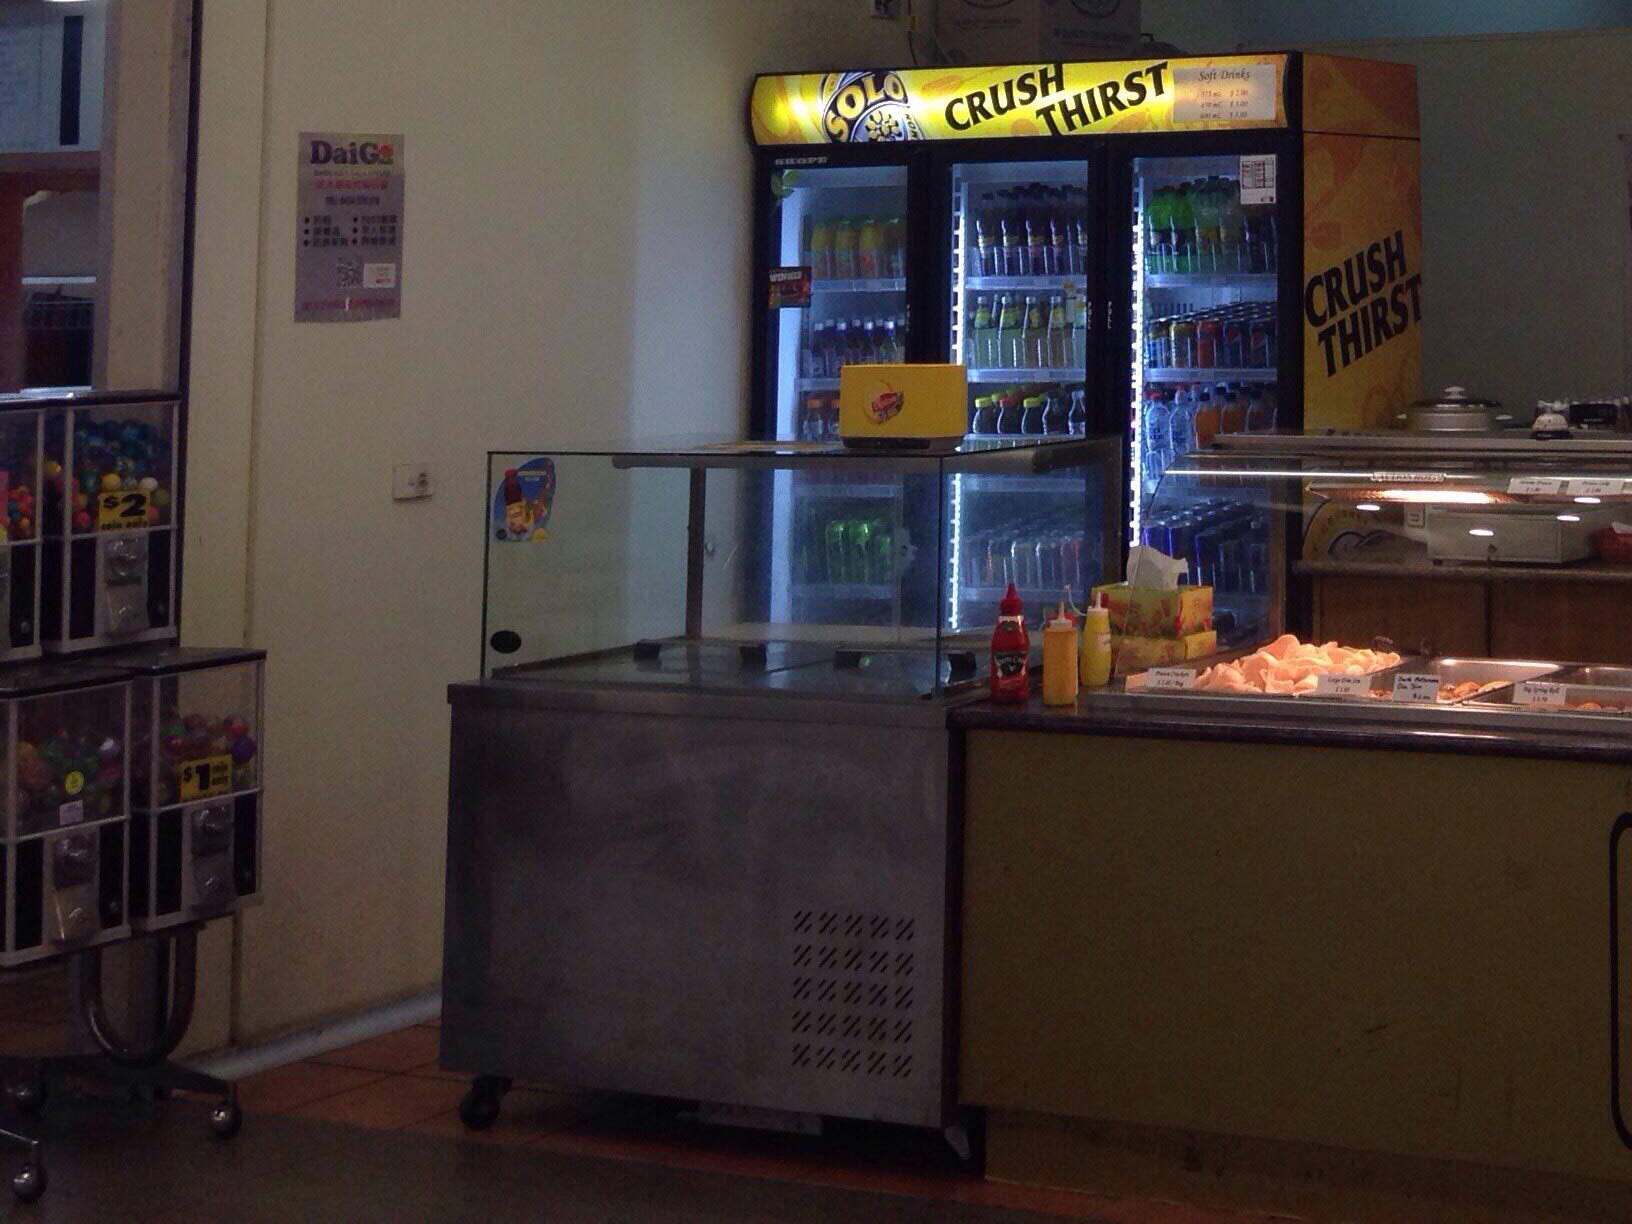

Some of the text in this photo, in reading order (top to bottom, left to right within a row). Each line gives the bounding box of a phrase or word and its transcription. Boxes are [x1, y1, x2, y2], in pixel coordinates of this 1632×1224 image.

[826, 72, 908, 142] SOLO
[945, 64, 1065, 131] CRUSH
[1036, 61, 1168, 136] THIRST
[1199, 68, 1249, 83] Soft Drinks
[1304, 229, 1408, 327] CRUSH
[1318, 273, 1422, 378] THIRST
